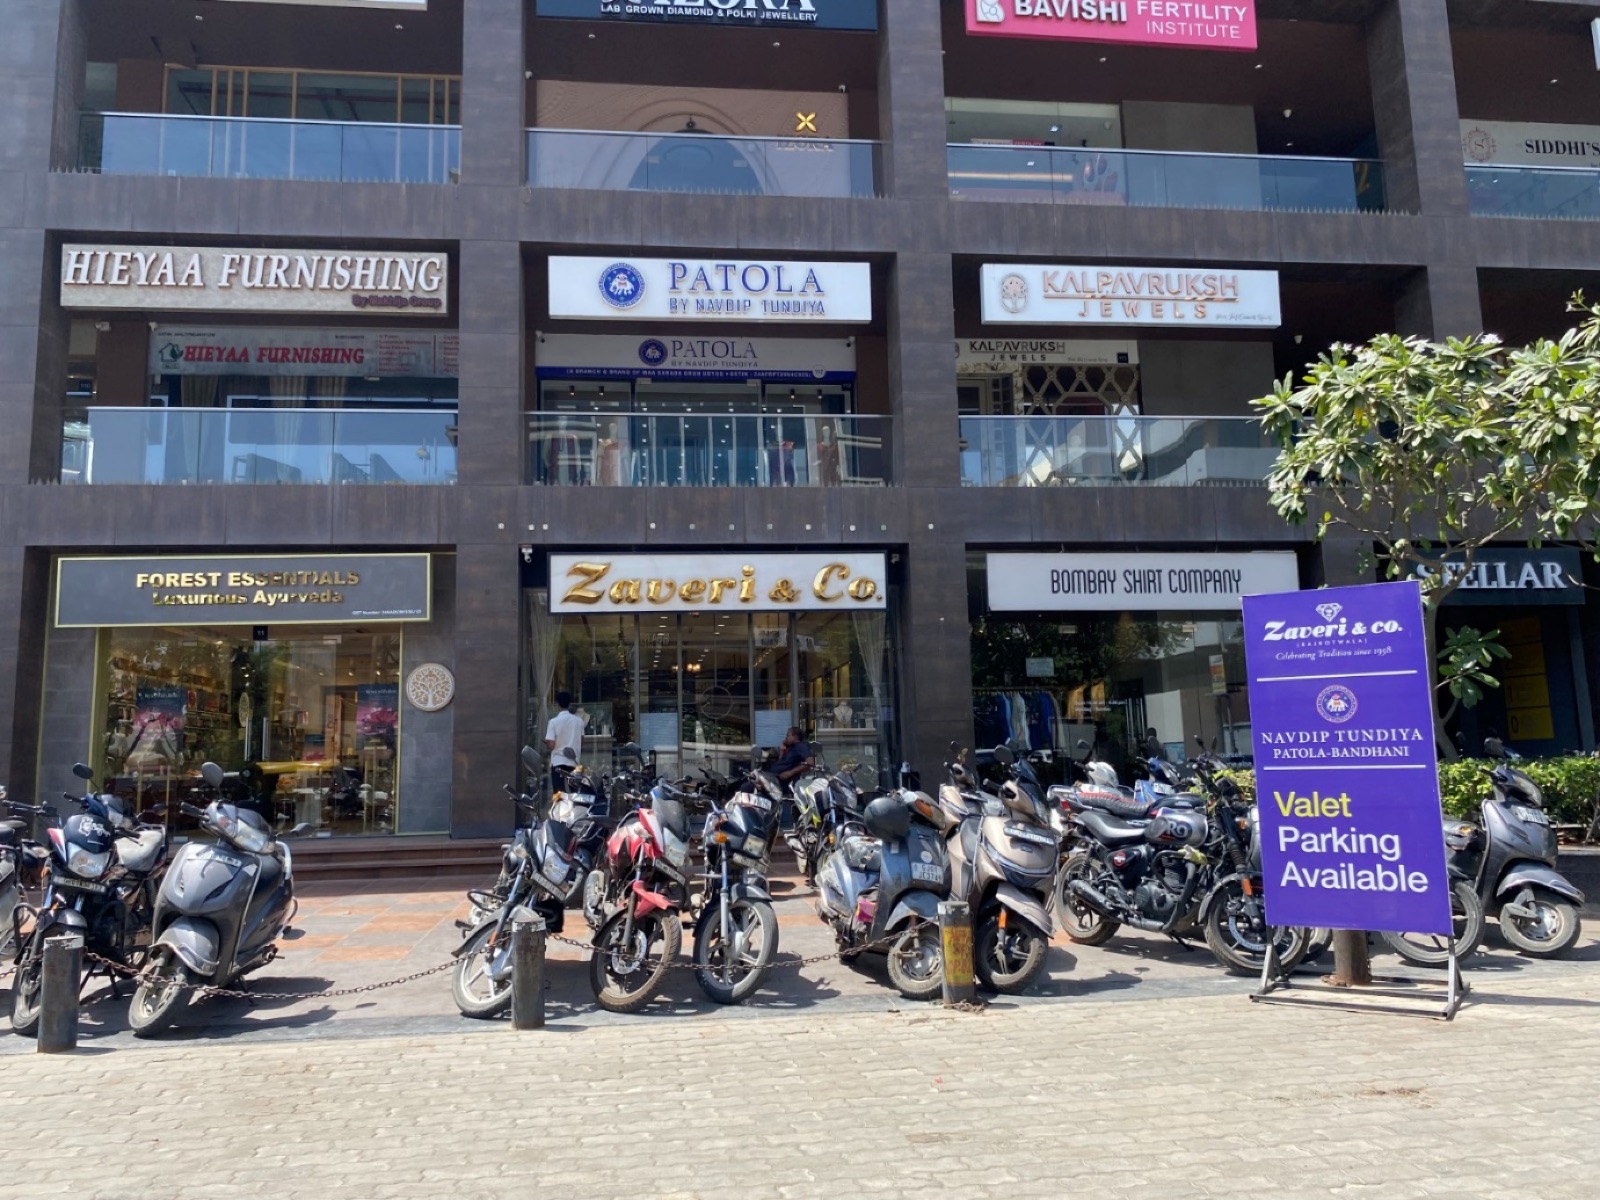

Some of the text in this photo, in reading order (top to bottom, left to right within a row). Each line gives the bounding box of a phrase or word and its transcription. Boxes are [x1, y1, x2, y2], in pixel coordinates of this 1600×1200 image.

[600, 4, 621, 13] LAB
[625, 5, 664, 15] GROWN
[667, 7, 714, 16] DIAMOND
[717, 9, 724, 17] &
[726, 9, 757, 18] POLKI
[760, 10, 818, 21] JEWELLERY
[1014, 0, 1247, 22] BAVISHI FERTILITY
[1146, 20, 1241, 39] INSTITUTE
[63, 250, 443, 293] HIEYAA FURNISHING
[668, 262, 825, 294] PATOLA
[1042, 269, 1240, 297] KALPAVRUKSH
[669, 297, 826, 316] BY NAVDIP TUNDIYA
[1078, 300, 1209, 320] JEWELS
[183, 344, 250, 363] HIEYAA
[256, 346, 365, 365] FURNISHING
[671, 340, 759, 360] PATOLA
[969, 340, 1066, 352] KALPAVRUKSH
[686, 360, 719, 368] NAVDIP
[990, 354, 1047, 362] JEWELS
[136, 571, 361, 588] FOREST ESSENTIALS
[561, 561, 883, 604] Zaveri & Co.
[1051, 569, 1242, 594] BOMBAY SHIRT COMPANY
[152, 590, 344, 607] Luxurious Ayurveda
[1263, 617, 1348, 642] Zaveri
[1351, 622, 1367, 636] &
[1275, 645, 1392, 661] Celebrating Tradition since 1958
[1261, 728, 1424, 744] NAVDIP TUNDIYA
[1273, 746, 1410, 759] PATOLA-BANDHANI
[1273, 791, 1353, 818] Valet
[1278, 826, 1401, 862] Parking
[1280, 861, 1429, 893] Available
